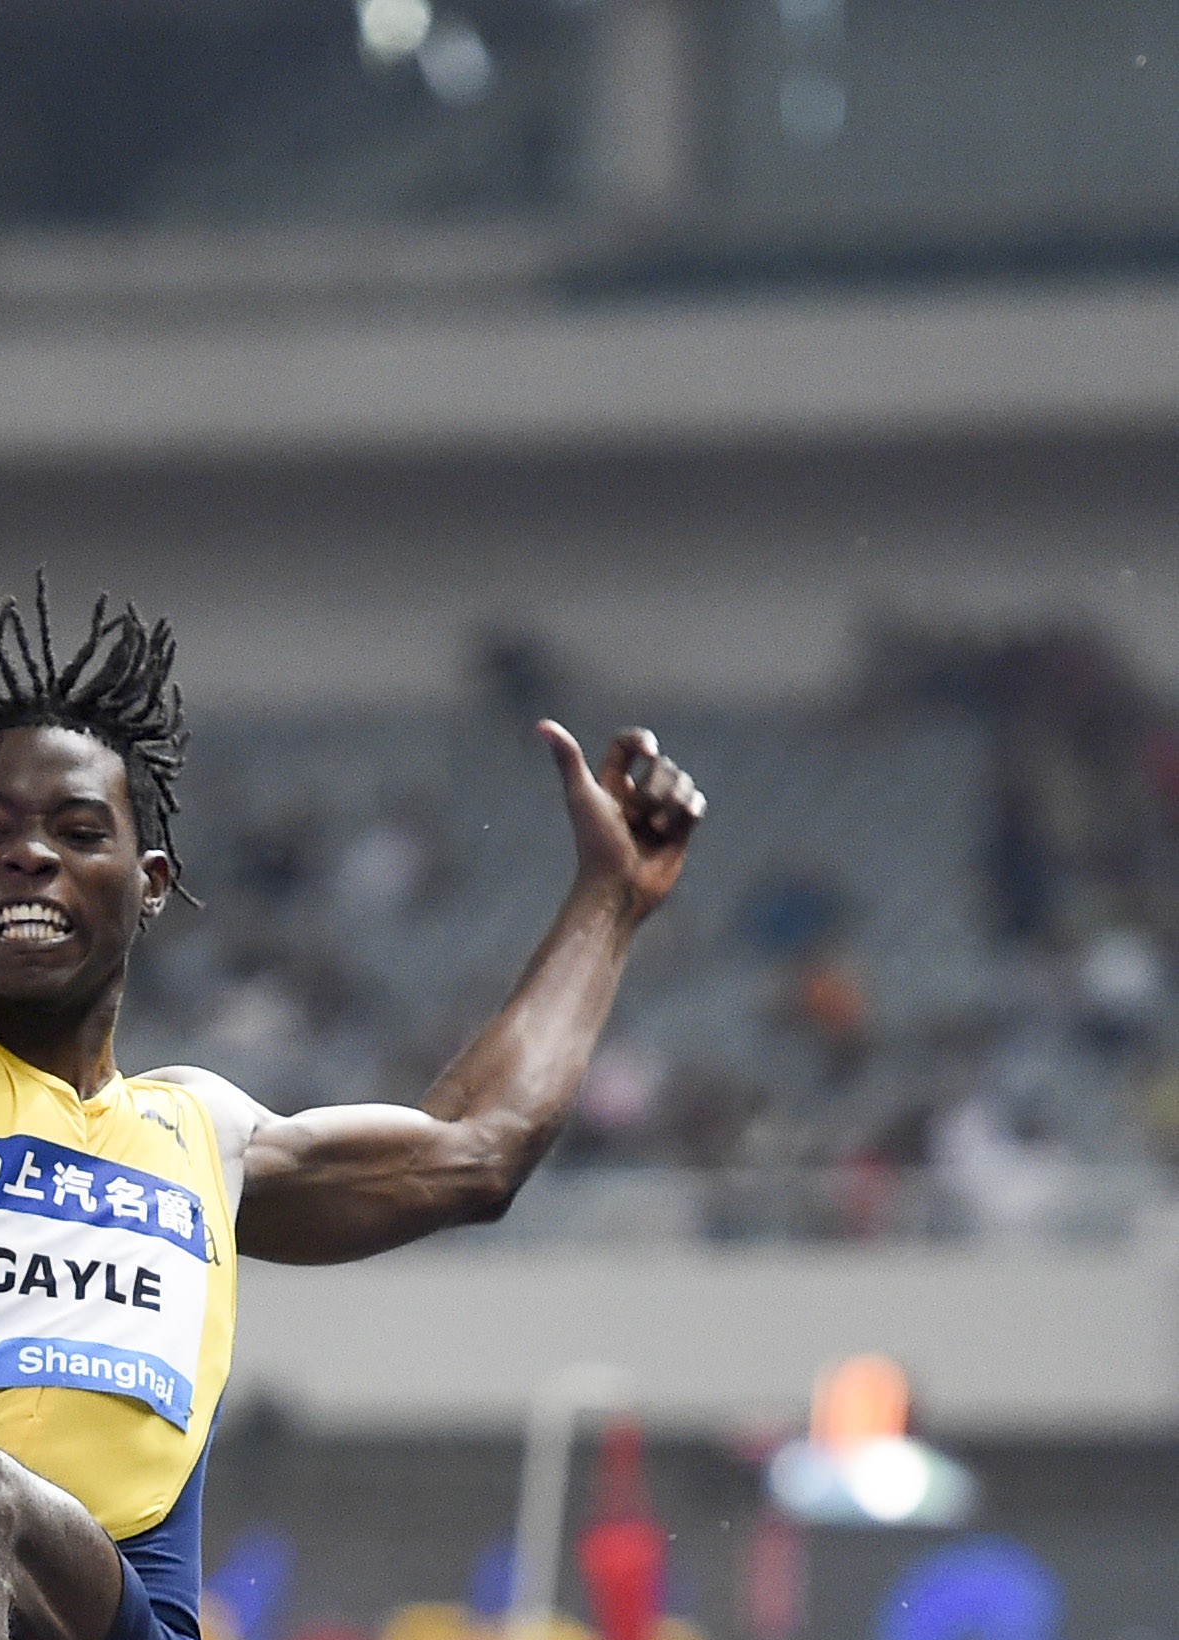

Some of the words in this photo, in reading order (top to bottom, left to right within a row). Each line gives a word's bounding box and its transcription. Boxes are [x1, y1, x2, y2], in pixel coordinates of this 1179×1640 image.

[3, 1150, 194, 1240] 上汽名爵
[18, 1345, 175, 1405] Shanghai
